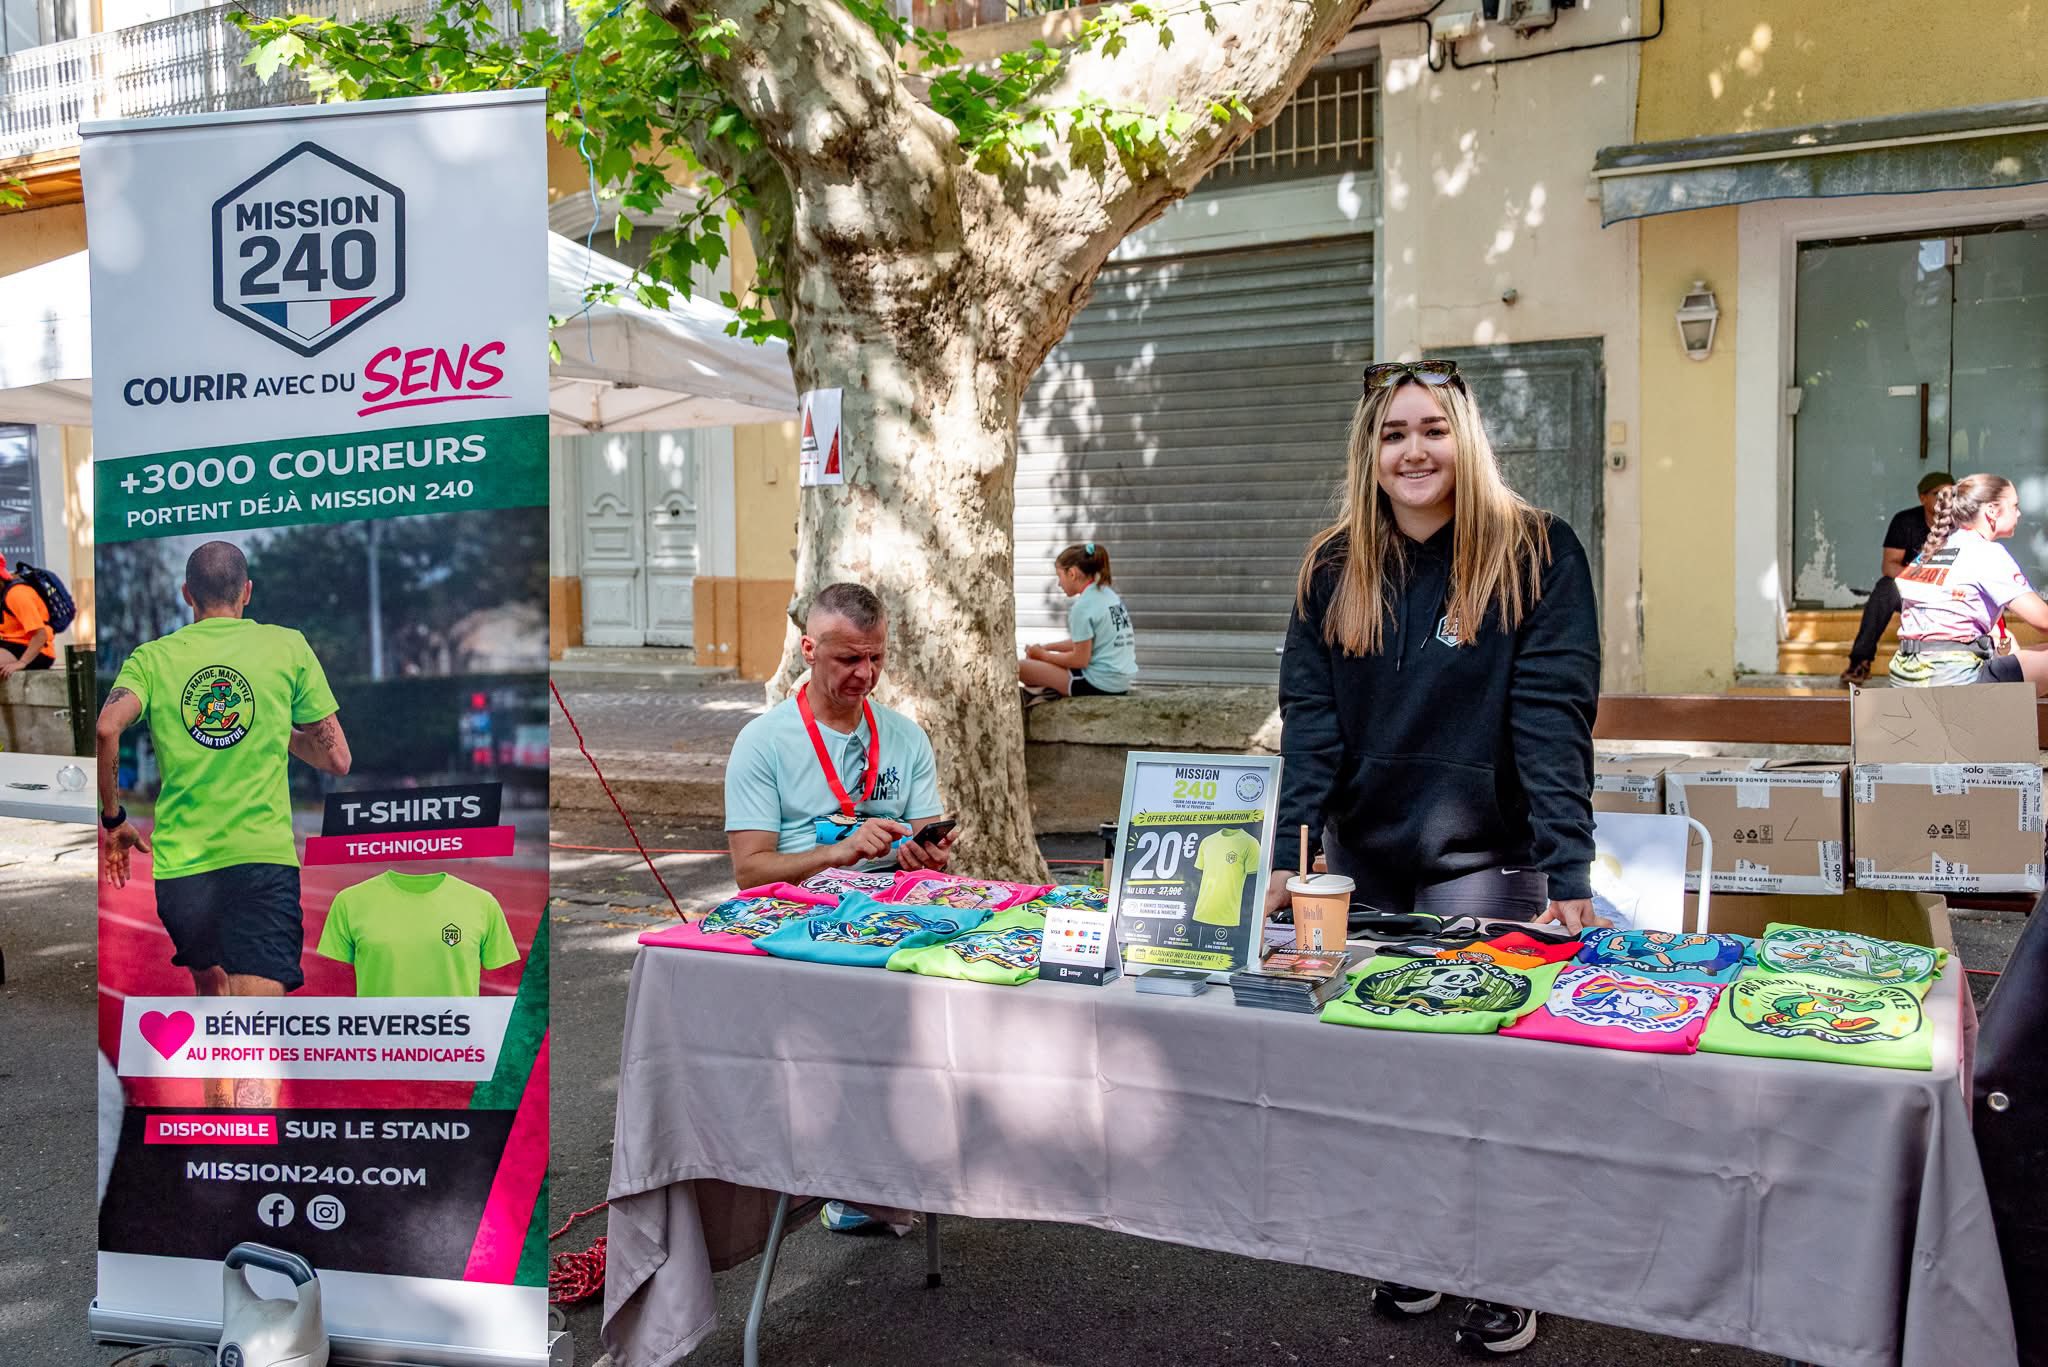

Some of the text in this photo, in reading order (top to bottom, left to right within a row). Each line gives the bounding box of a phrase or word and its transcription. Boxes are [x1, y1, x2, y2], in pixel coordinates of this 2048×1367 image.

[236, 194, 379, 232] MISSION
[239, 228, 377, 297] 240
[123, 340, 506, 407] COURIR AVEC DU SENS
[119, 433, 487, 495] +3000 COUREURS
[126, 479, 474, 528] PORTENT DÉJÀ MISSION 240
[184, 690, 194, 706] PAS
[190, 669, 217, 690] RAPIDE,
[218, 669, 238, 683] MAIS
[191, 727, 245, 747] TEAM TORTUE
[1175, 767, 1220, 781] MISSION
[1963, 766, 1984, 774] solo
[1172, 780, 1217, 800] 240
[341, 795, 481, 826] T-SHIRTS
[1146, 815, 1166, 823] OFFRE
[1199, 813, 1250, 822] SEMI-MARATHON
[346, 837, 463, 857] TECHNIQUES
[1130, 831, 1199, 880] 20€
[1749, 876, 1783, 884] GARANTIE
[1835, 863, 1843, 882] solo
[1127, 887, 1134, 895] AU
[1135, 887, 1148, 895] LIEU
[1148, 887, 1155, 895] DE
[445, 932, 458, 940] 240
[1787, 930, 1840, 939] TEAM
[1644, 943, 1665, 951] 240
[1436, 957, 1471, 966] MAIS
[1433, 987, 1458, 998] 240
[1739, 980, 1761, 997] PAS
[205, 1009, 471, 1037] BÉNÉFICES REVERSÉS
[1755, 1024, 1895, 1044] TEAM TORTUE
[186, 1046, 486, 1063] AU PROFIT DES ENFANTS HANDICAPÉS
[159, 1121, 471, 1141] DISPONIBLE SUR LE STAND
[186, 1161, 426, 1186] MISSION240.COM
